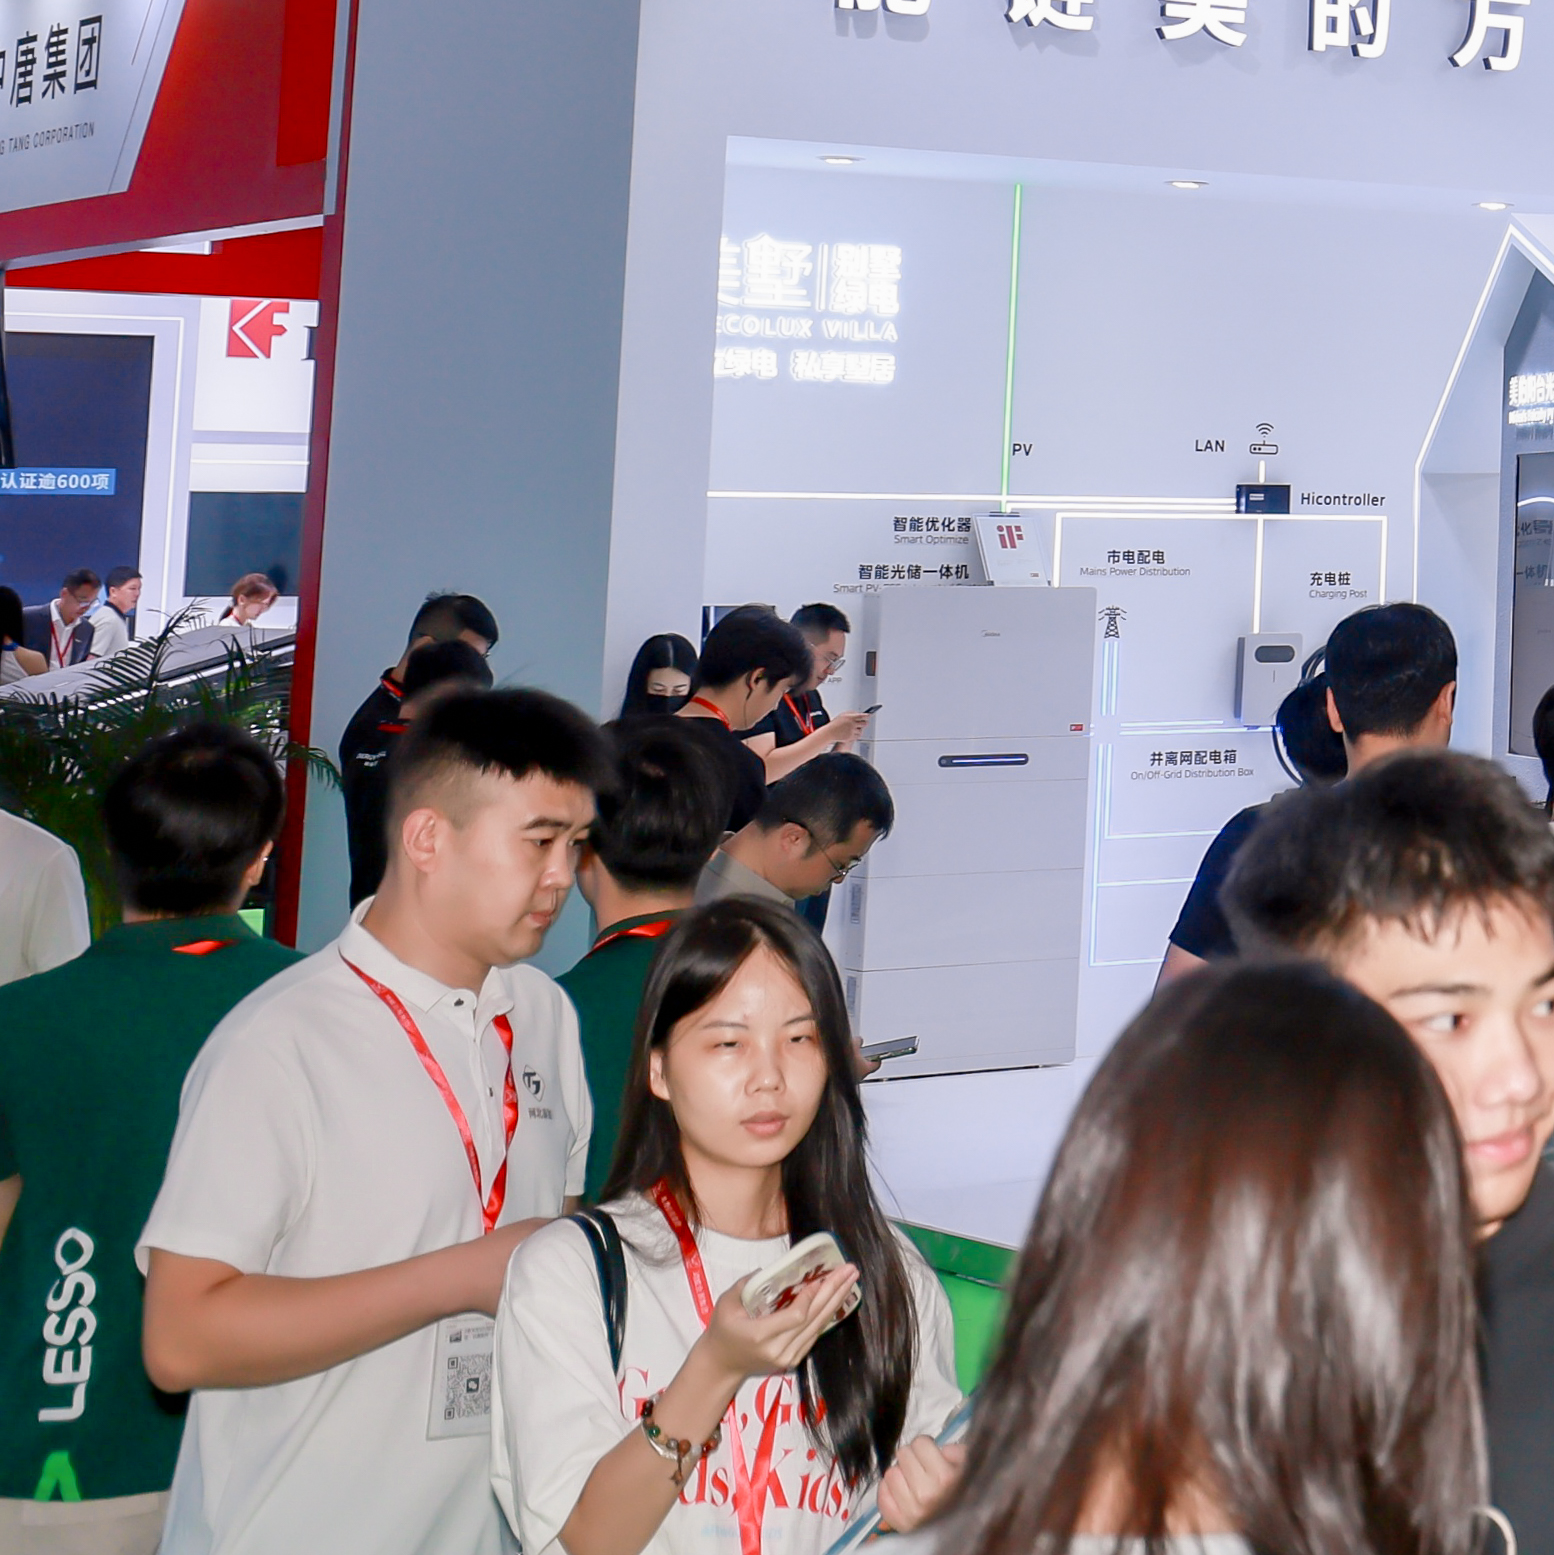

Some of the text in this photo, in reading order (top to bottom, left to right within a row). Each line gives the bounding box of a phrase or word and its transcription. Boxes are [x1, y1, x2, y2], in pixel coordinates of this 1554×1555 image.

[33, 121, 95, 149] CORPORATION
[822, 318, 899, 343] VILLA
[1011, 442, 1033, 456] PV
[1194, 438, 1226, 453] LAN
[0, 472, 110, 491] 认证逾600项
[1299, 491, 1386, 508] Hicontroller
[892, 516, 972, 533] 智能优化器
[893, 534, 923, 544] Smart
[1106, 549, 1166, 565] 市电配电
[857, 563, 970, 581] 智能光储一体机
[1079, 566, 1191, 576] Mains Power Distribution
[1309, 571, 1352, 587] 充电桩
[833, 583, 863, 594] Smart
[1308, 589, 1368, 599] Charging Post
[1149, 749, 1238, 767] 并离网配电箱
[1184, 768, 1236, 779] Distribution
[1237, 767, 1255, 777] Box
[38, 1227, 97, 1422] LESSO
